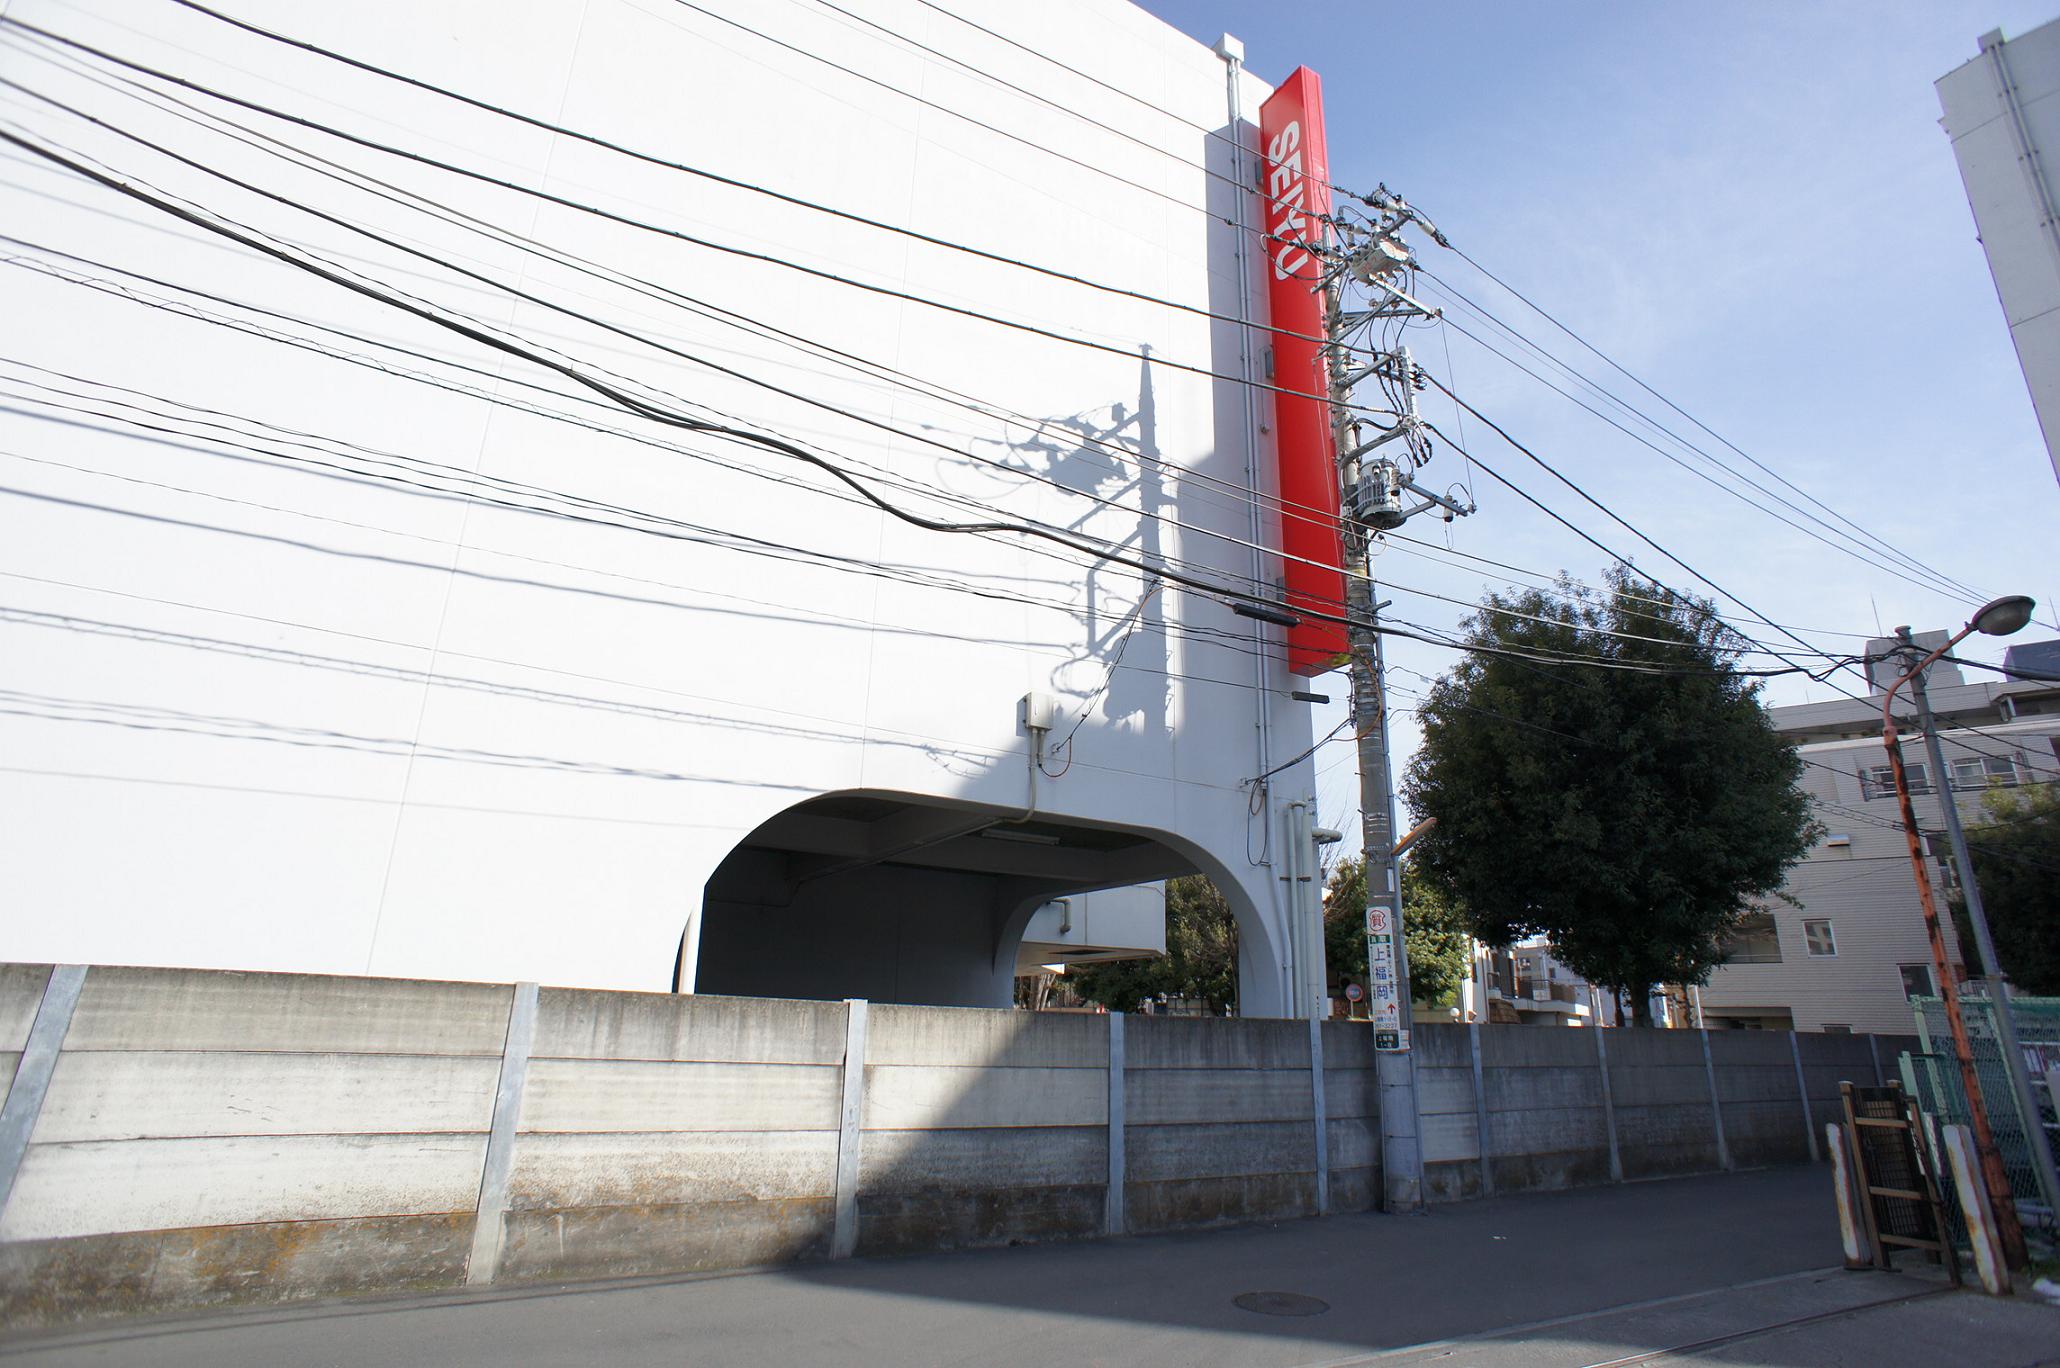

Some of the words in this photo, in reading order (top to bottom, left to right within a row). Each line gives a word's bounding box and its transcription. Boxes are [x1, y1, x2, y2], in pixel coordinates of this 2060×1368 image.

[1268, 120, 1309, 281] SEIYU
[1375, 947, 1388, 999] 上福岡
